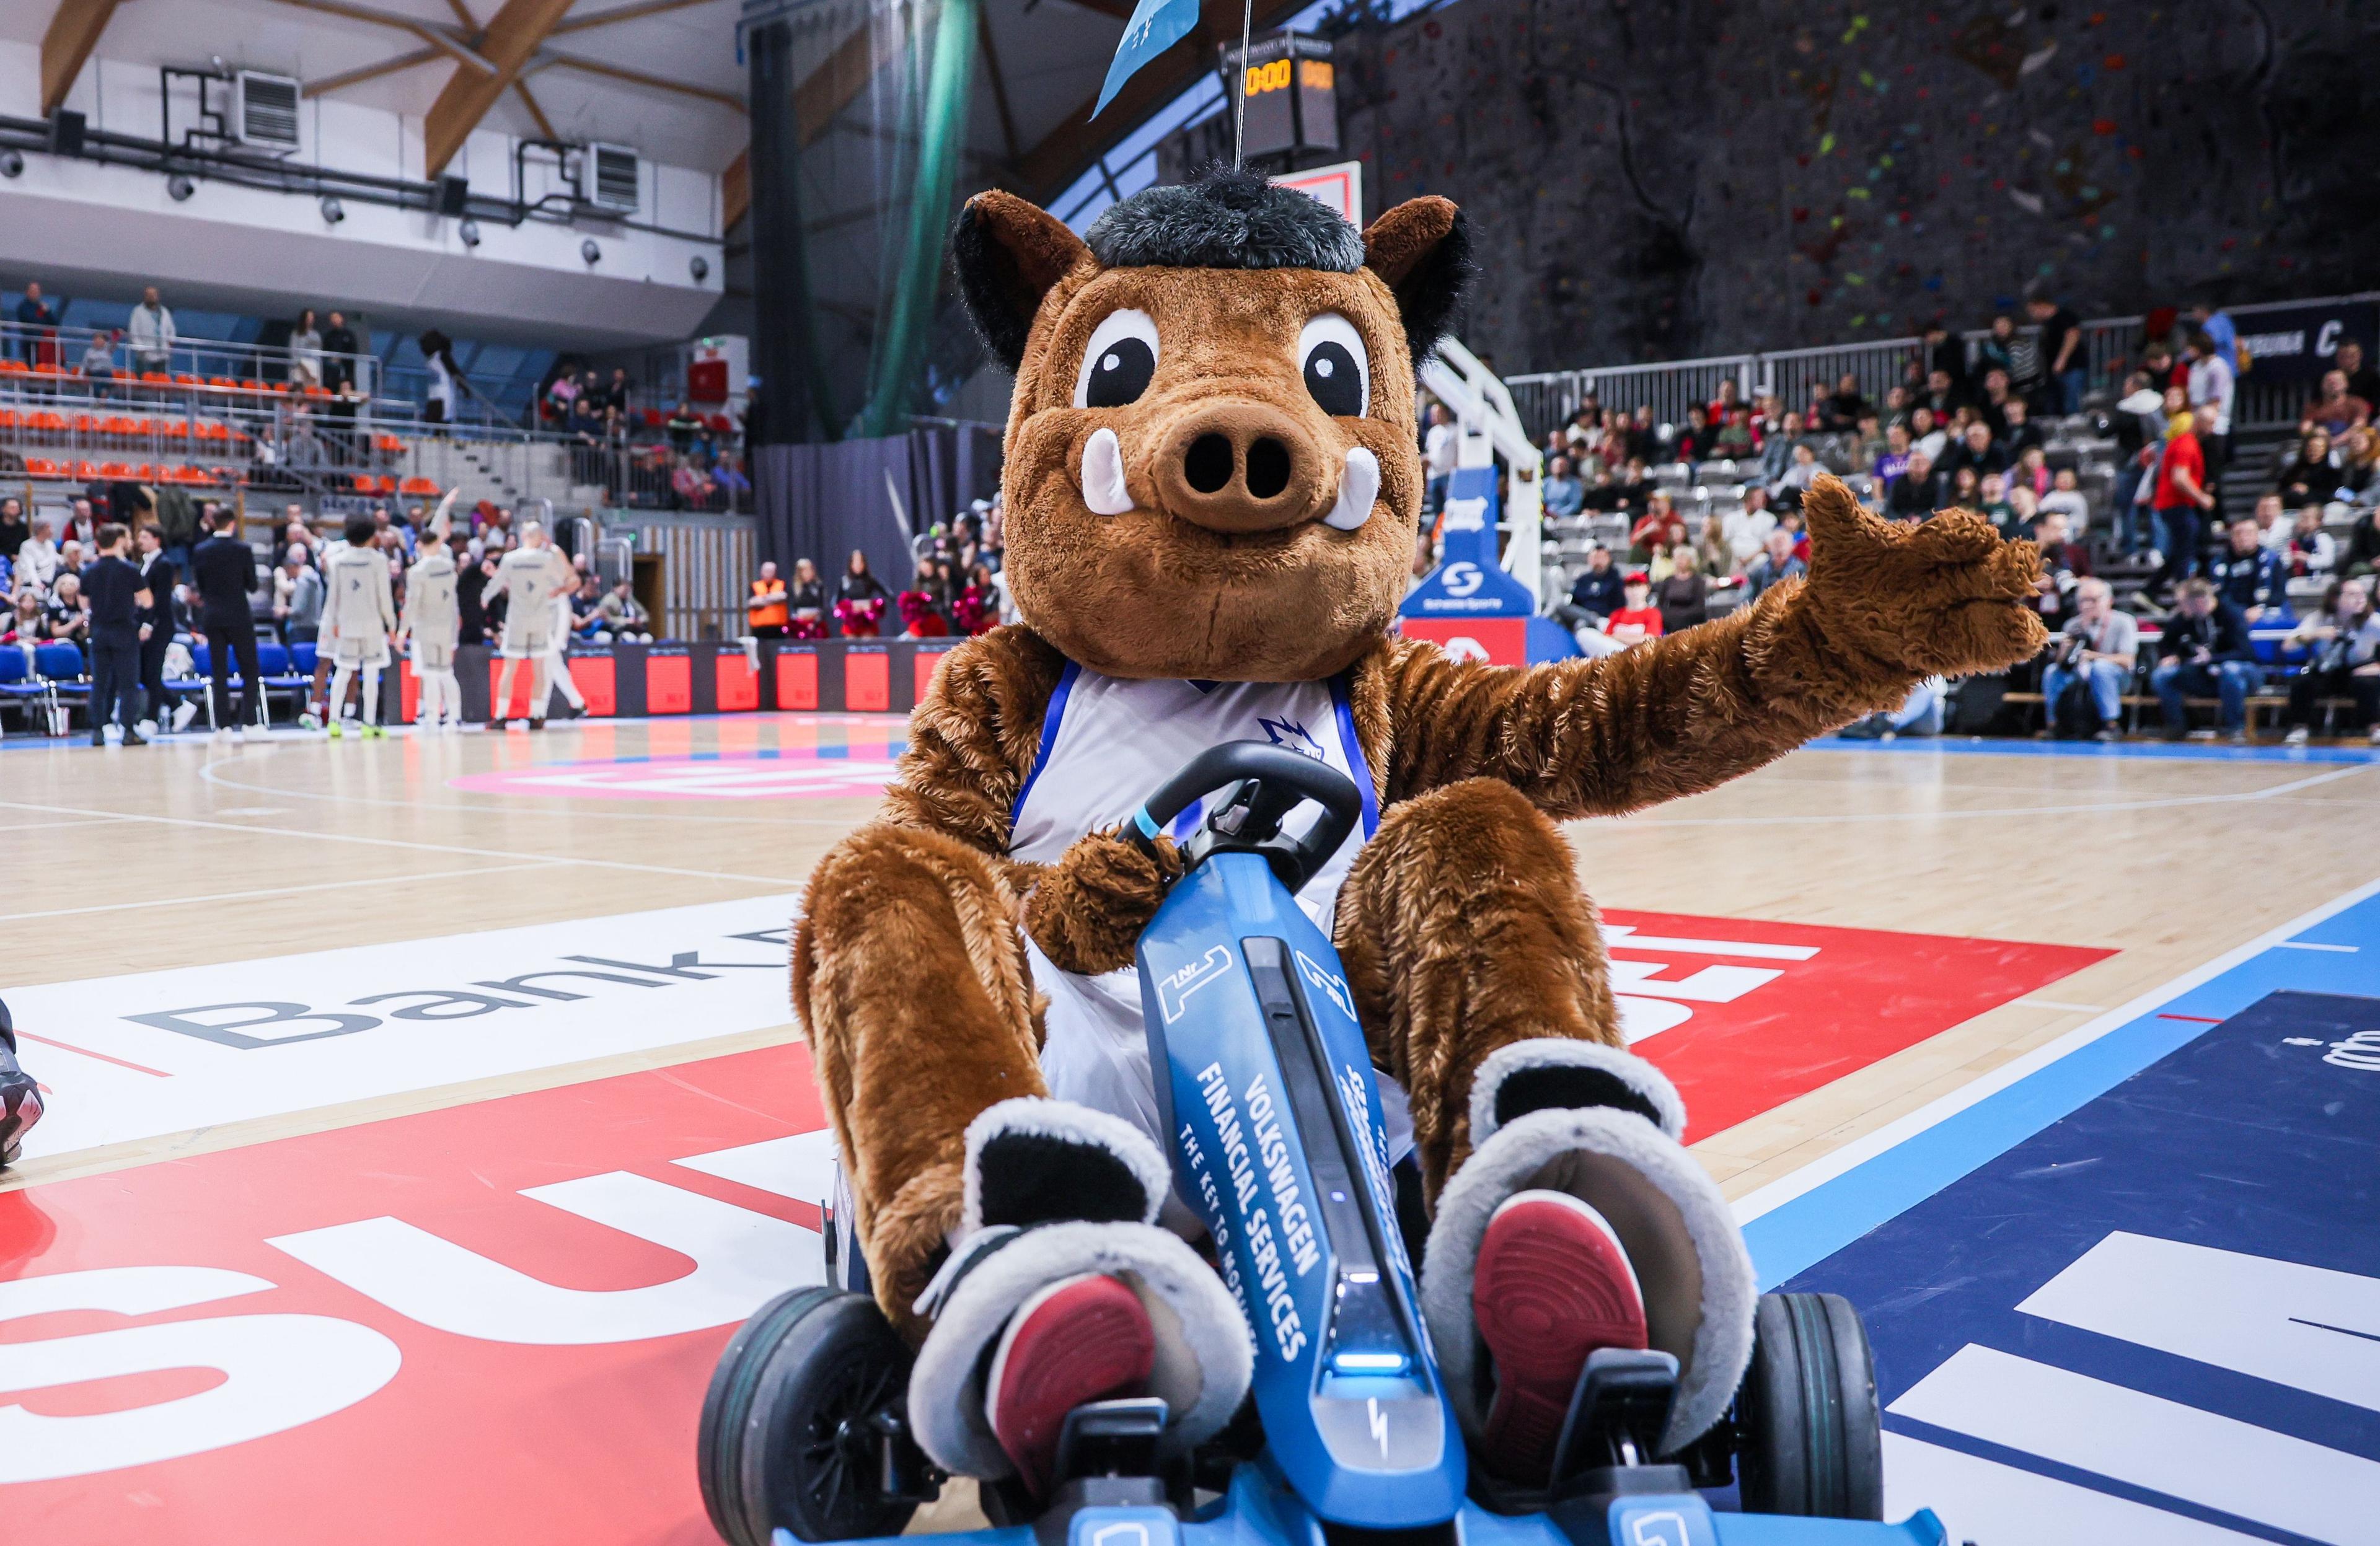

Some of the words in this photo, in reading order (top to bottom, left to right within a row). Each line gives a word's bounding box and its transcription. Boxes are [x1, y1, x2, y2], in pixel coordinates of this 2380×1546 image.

[118, 950, 787, 1050] Bank
[1178, 962, 1197, 981] Nr
[1179, 1123, 1204, 1170] THE
[1199, 1170, 1220, 1213] KEY
[1214, 1214, 1228, 1247] TO
[1197, 1061, 1258, 1215] FINANCIAL
[1245, 1208, 1307, 1362] SERVICES
[1245, 1073, 1320, 1276] VOLKSWAGEN
